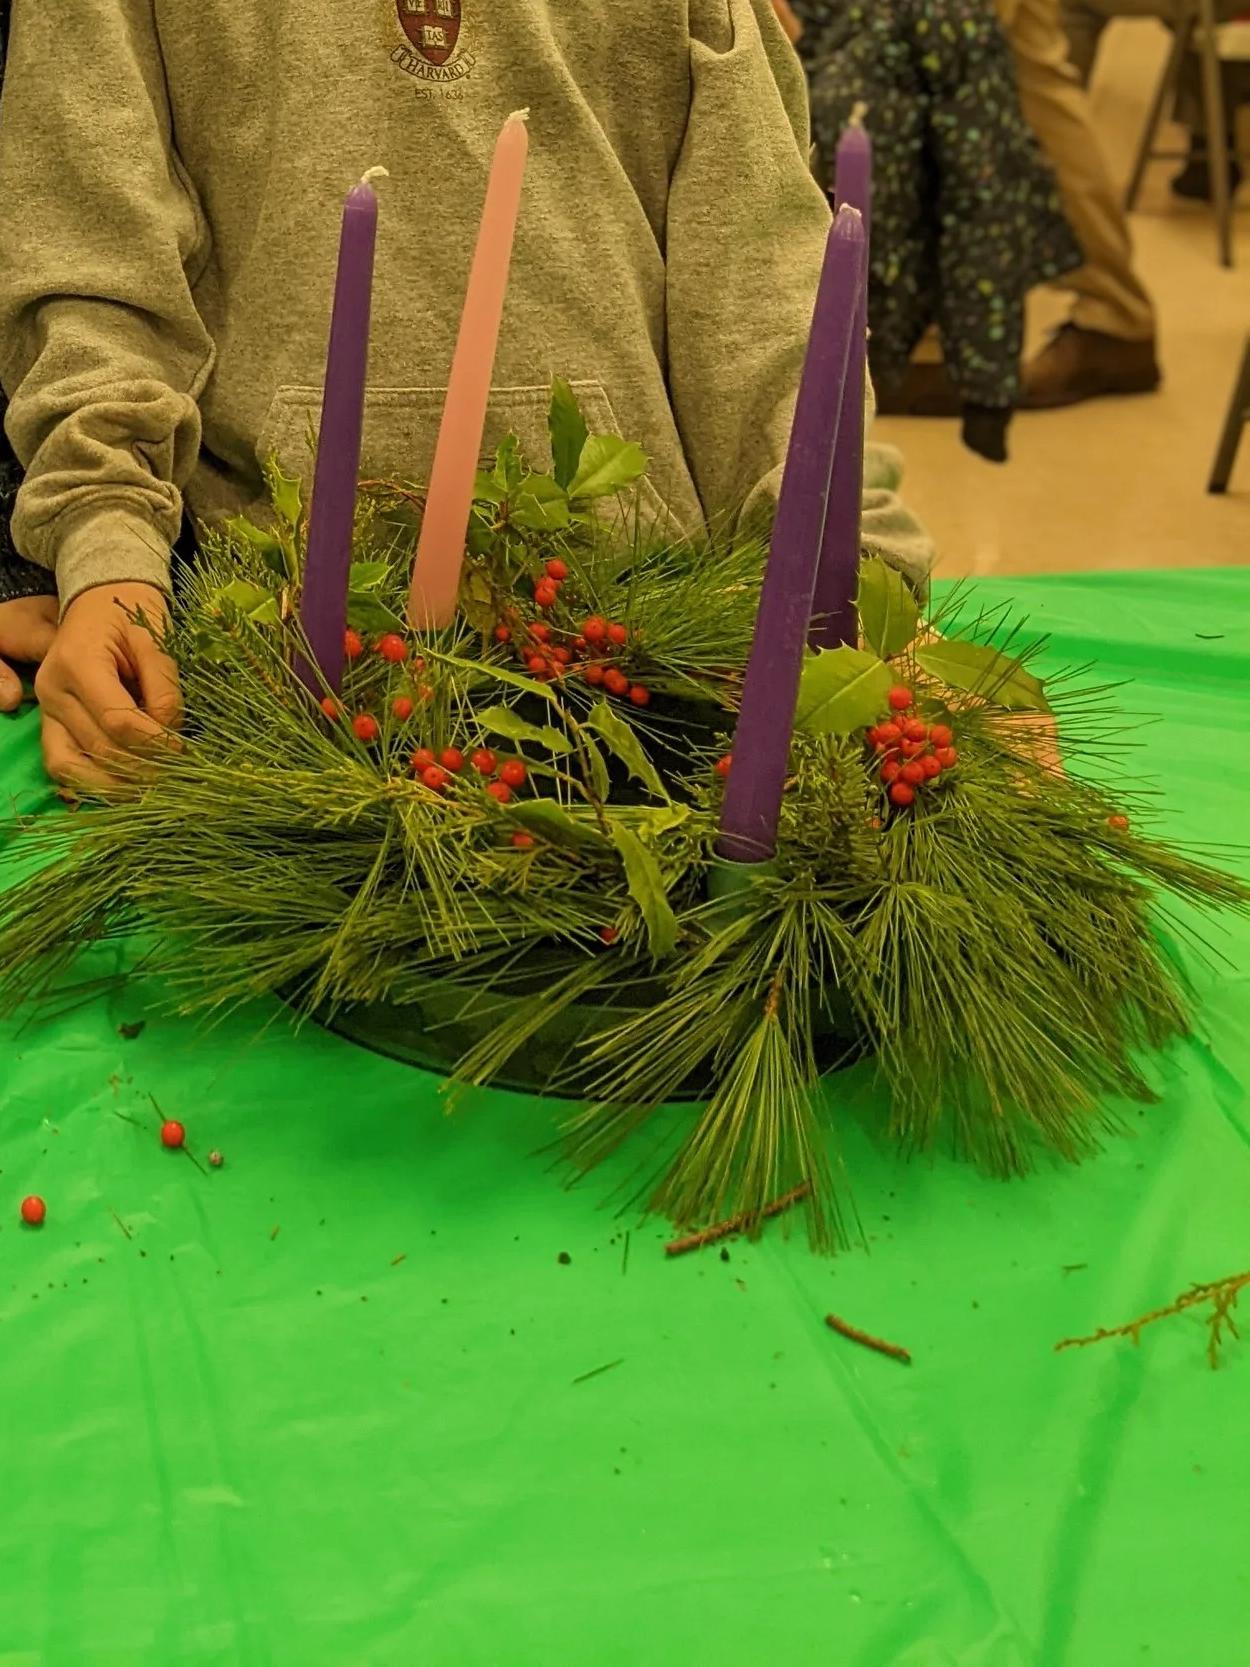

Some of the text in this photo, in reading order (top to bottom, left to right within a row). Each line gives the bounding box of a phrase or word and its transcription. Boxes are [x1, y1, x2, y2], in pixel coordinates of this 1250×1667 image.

[426, 29, 443, 41] TAS
[406, 58, 464, 80] HARVARD
[414, 87, 464, 100] EST. 1636
